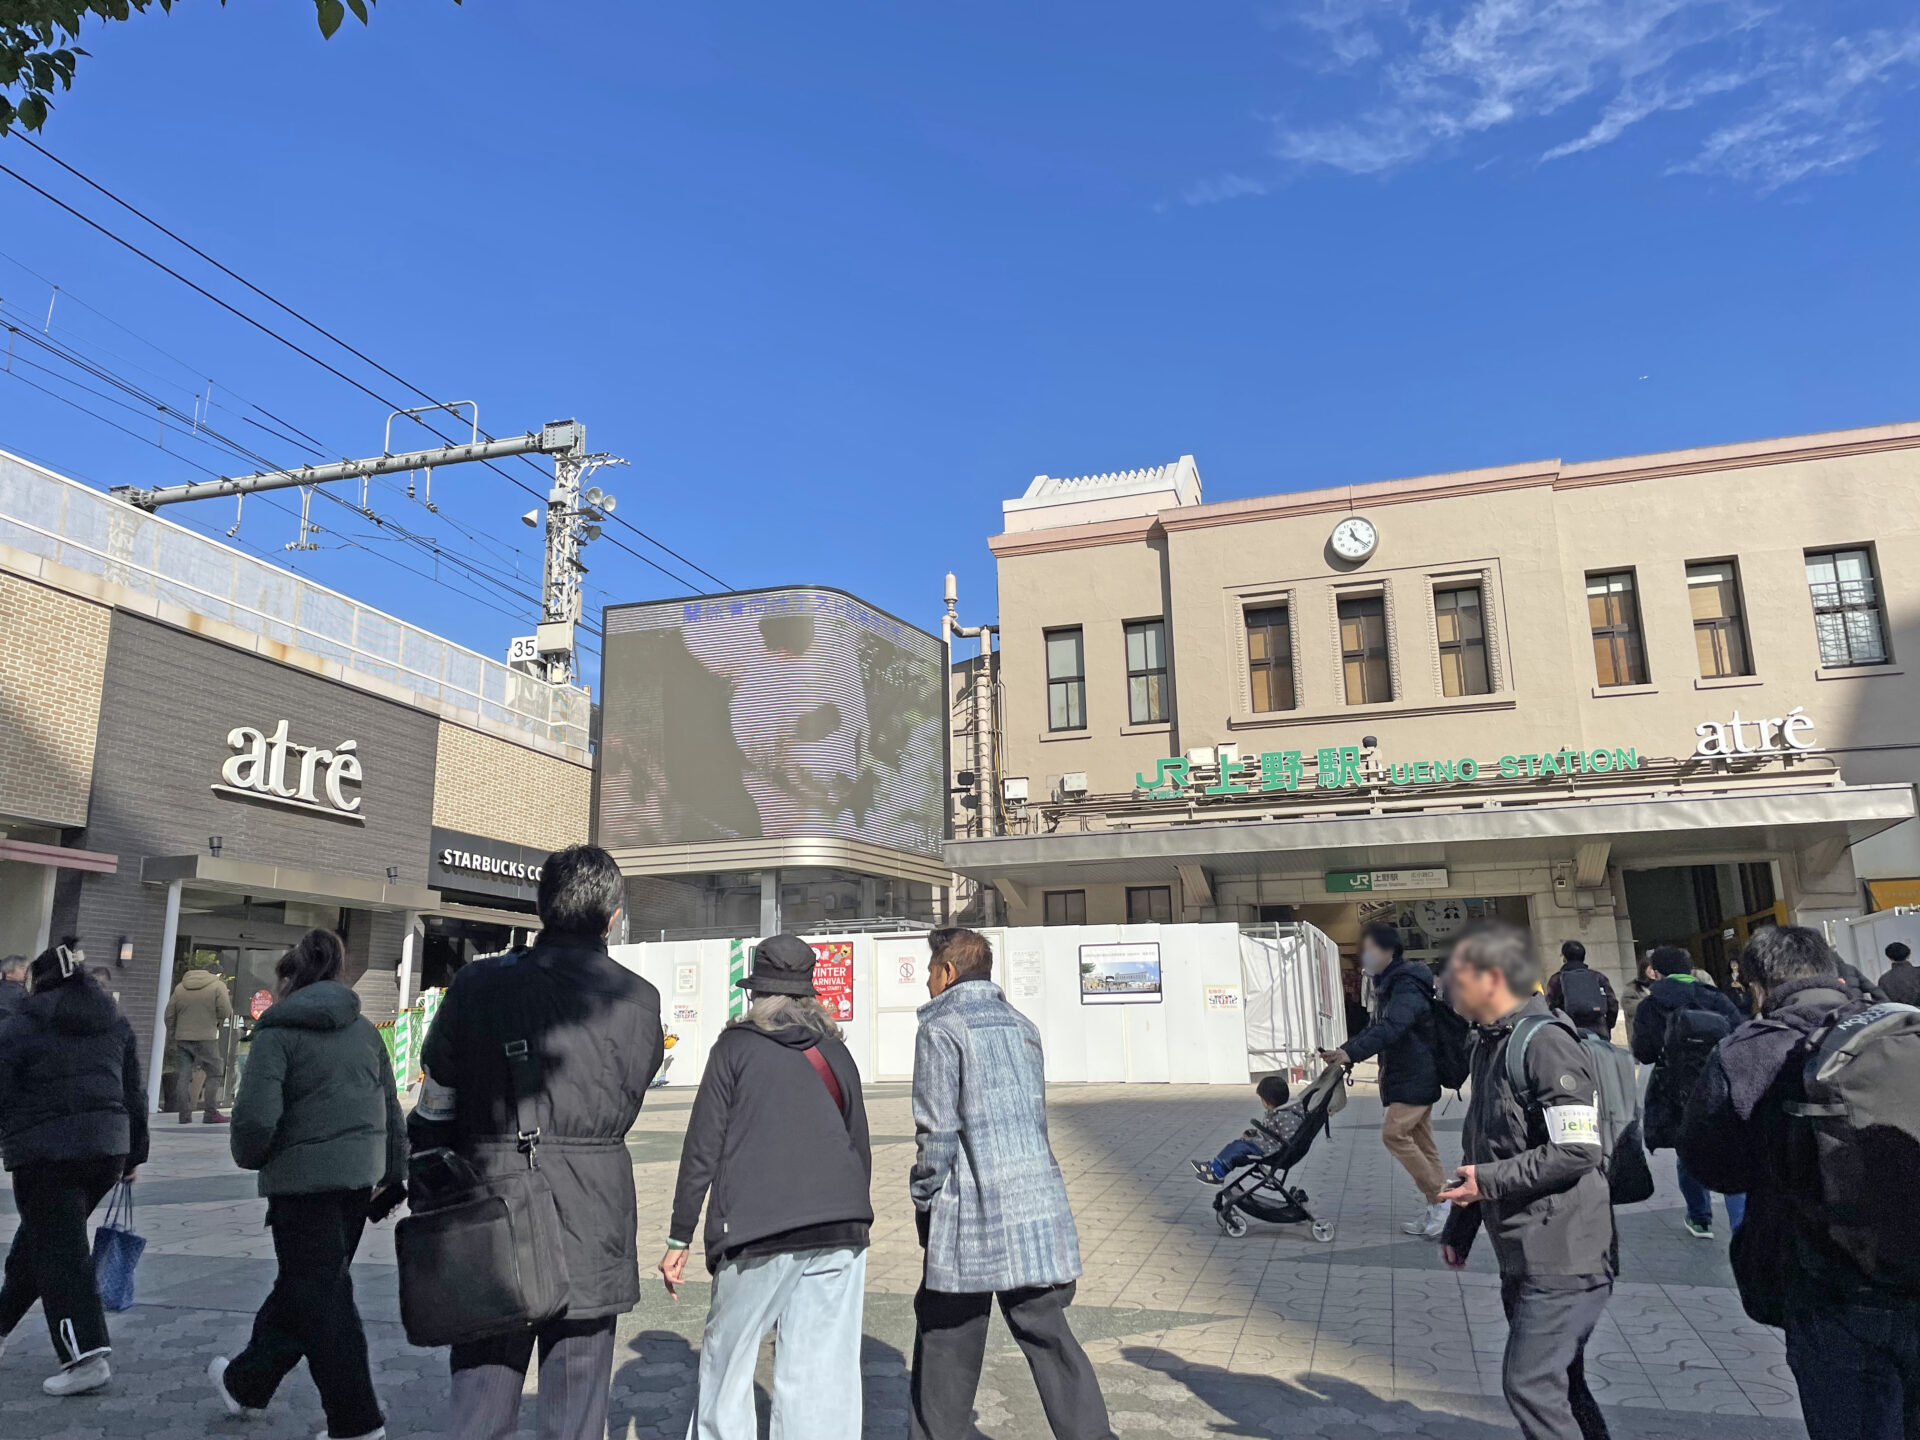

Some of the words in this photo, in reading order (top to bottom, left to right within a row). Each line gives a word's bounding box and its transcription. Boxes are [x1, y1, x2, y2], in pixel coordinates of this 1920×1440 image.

[514, 640, 535, 657] 35
[1696, 707, 1816, 756] atré
[221, 719, 363, 812] atré
[1135, 757, 1190, 790] JR
[1206, 746, 1363, 795] 上野駅
[1390, 757, 1478, 785] UENO
[1500, 747, 1639, 779] STATION
[443, 848, 525, 879] STARBUCKS
[1350, 874, 1369, 886] JR
[1374, 873, 1399, 882] 上野駅
[812, 977, 846, 985] ARNIVAL
